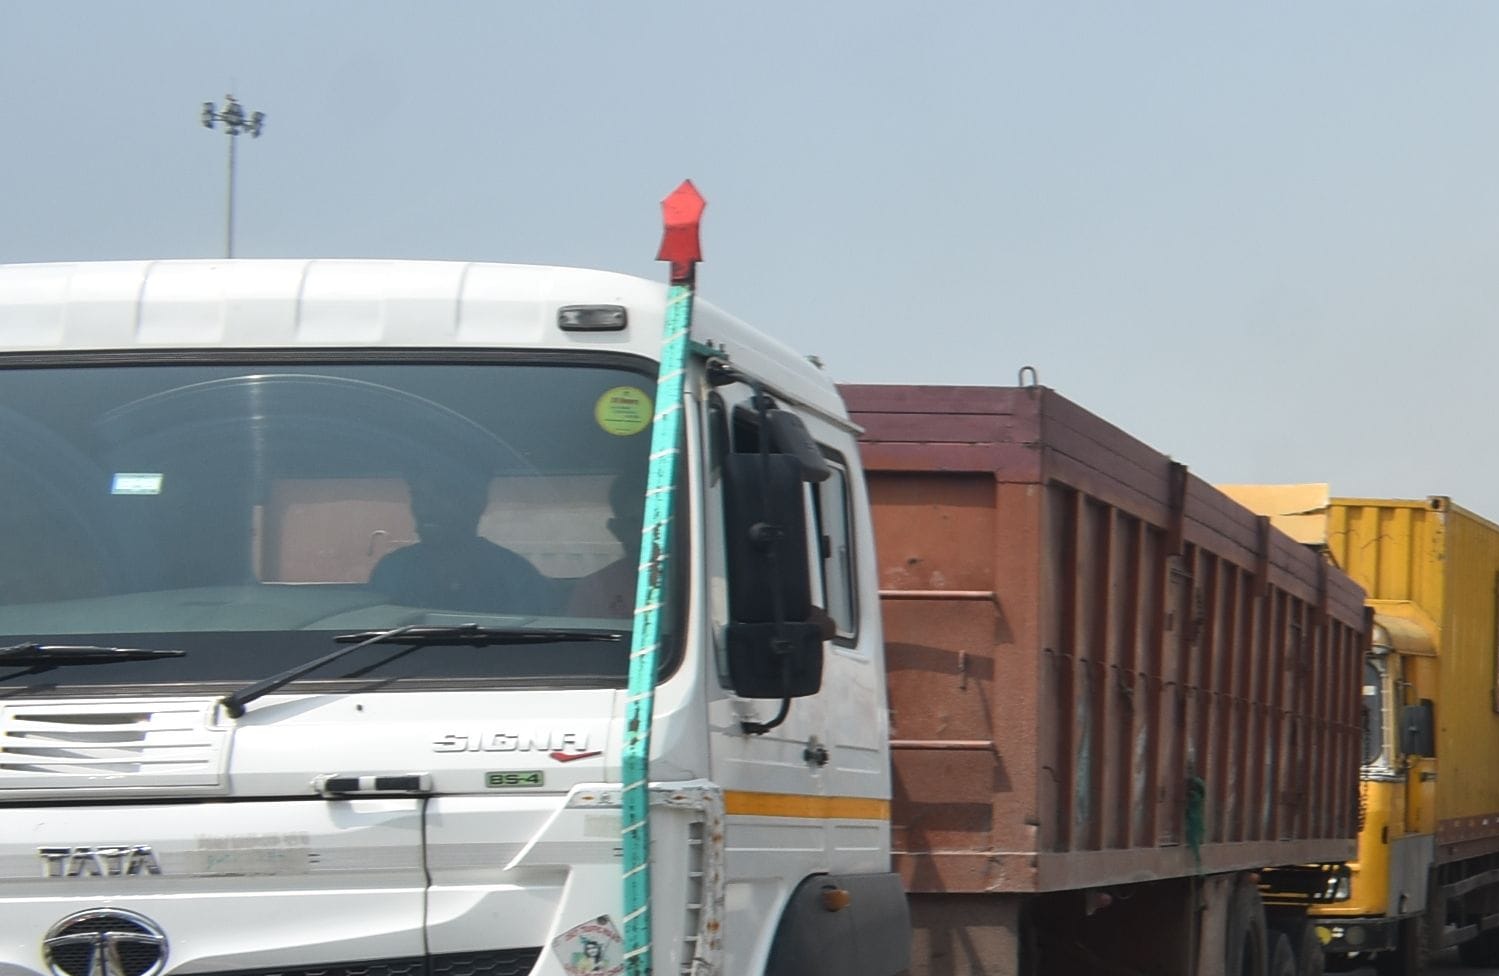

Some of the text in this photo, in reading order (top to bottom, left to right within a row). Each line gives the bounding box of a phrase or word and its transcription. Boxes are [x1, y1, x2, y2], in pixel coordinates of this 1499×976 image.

[433, 732, 593, 752] SIGNA
[489, 774, 540, 786] BS-4
[38, 845, 163, 877] TATA
